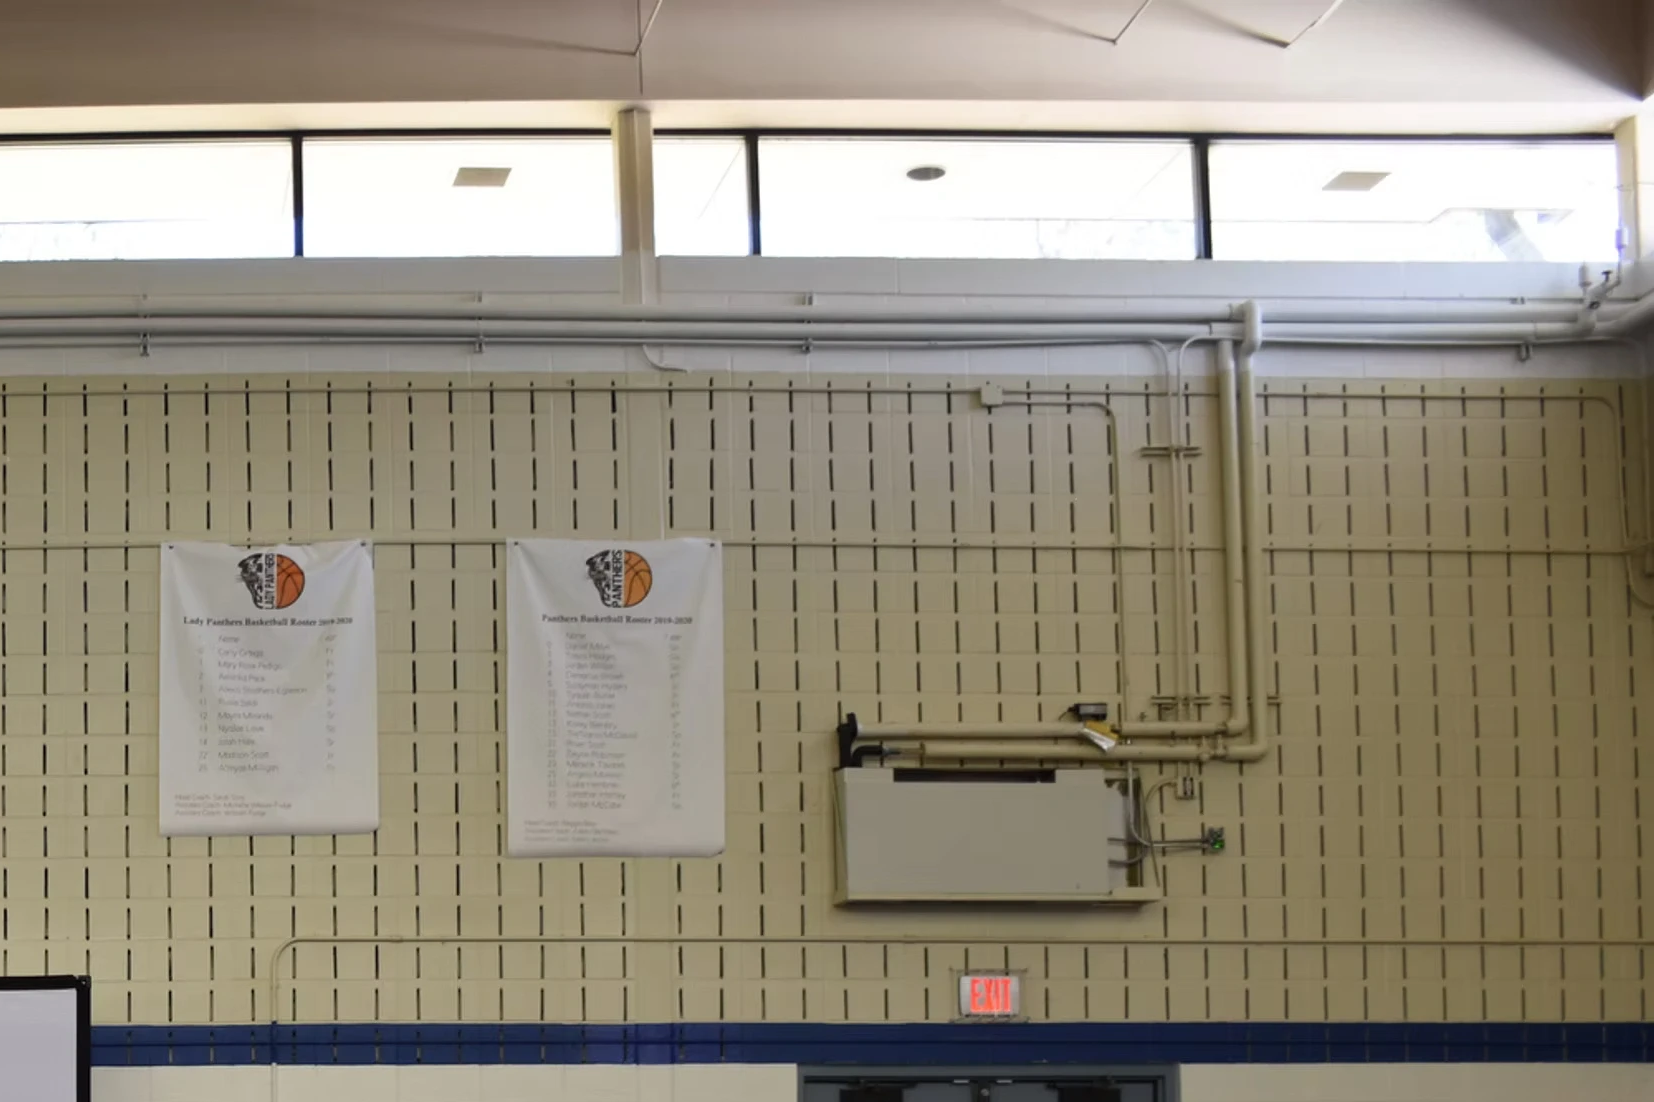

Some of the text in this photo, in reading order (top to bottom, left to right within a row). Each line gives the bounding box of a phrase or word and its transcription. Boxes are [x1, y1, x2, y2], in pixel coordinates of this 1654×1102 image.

[611, 550, 623, 608] PANTHERS
[183, 616, 204, 627] Lady
[206, 617, 243, 627] Panthers
[245, 618, 288, 626] Basketball
[289, 618, 317, 626] Roster
[542, 614, 578, 623] Panthers
[580, 614, 623, 623] Basketball
[625, 615, 652, 624] Roster
[970, 978, 1011, 1013] EXIT
